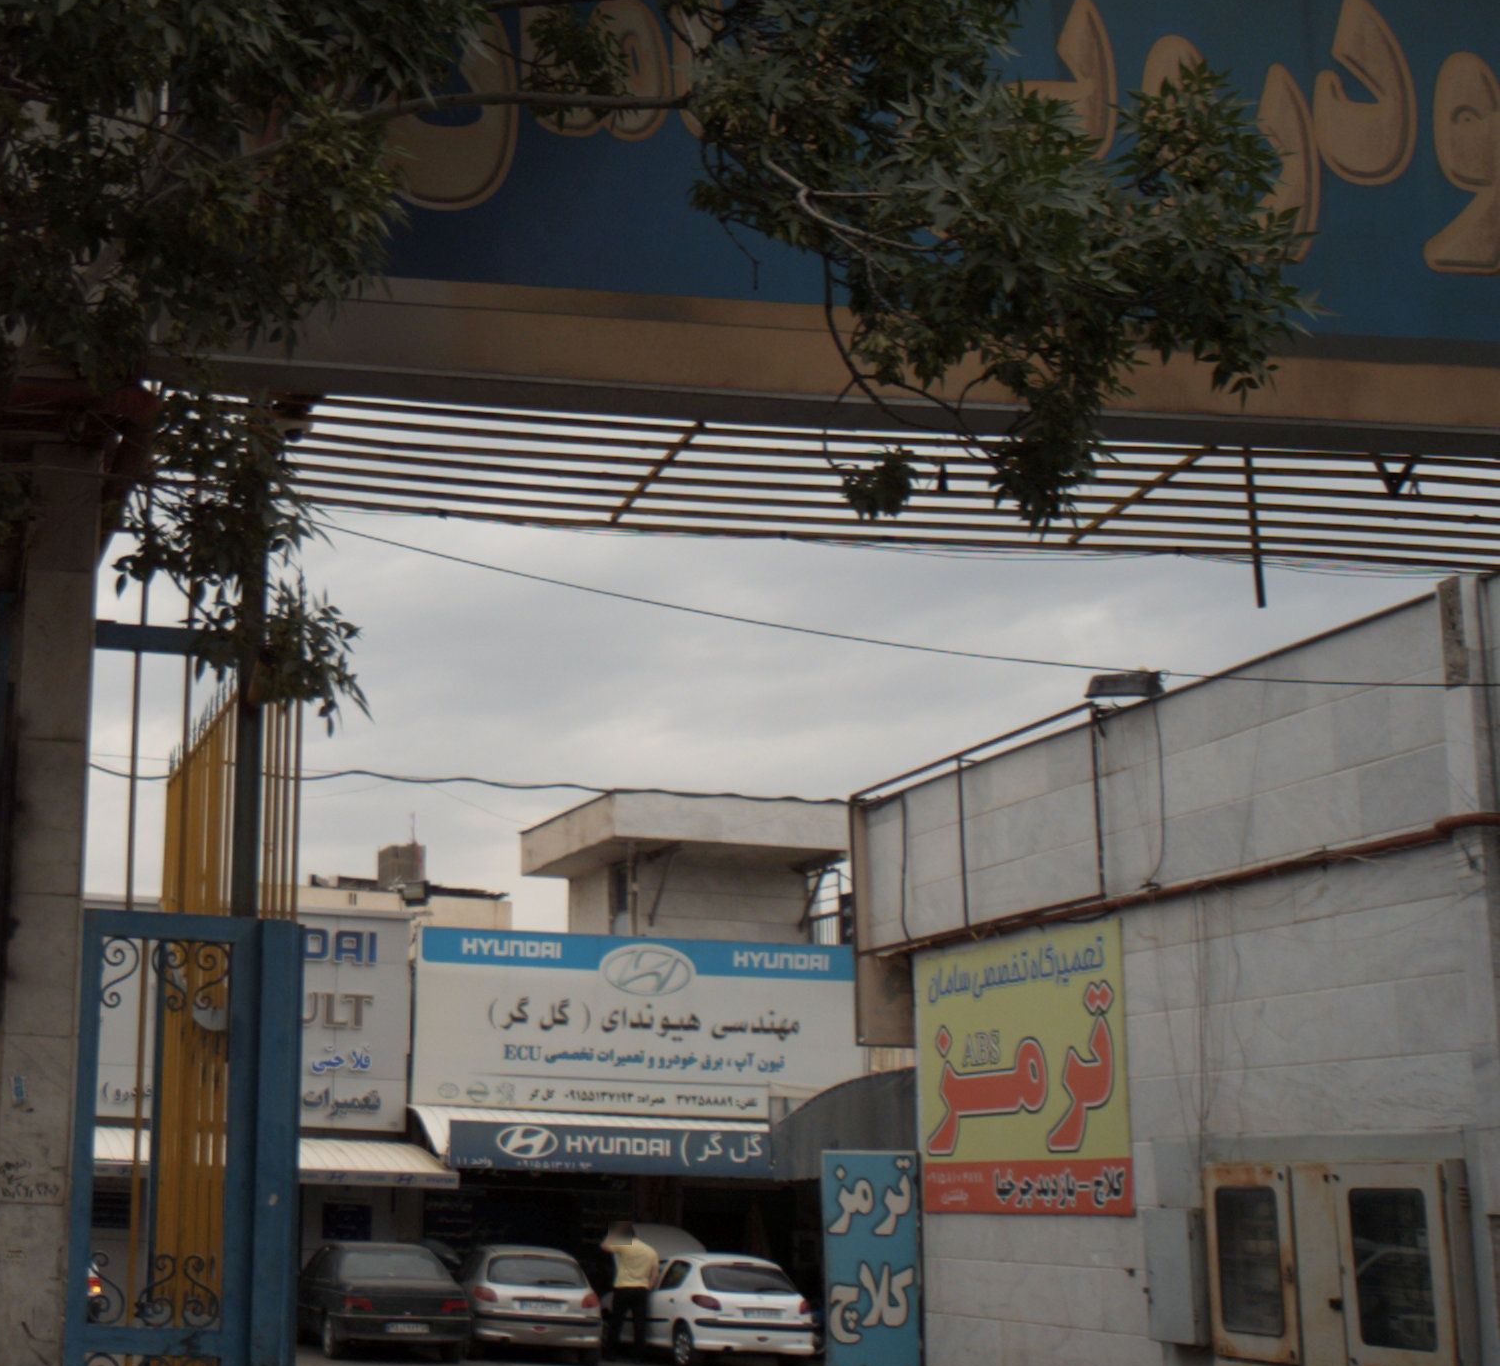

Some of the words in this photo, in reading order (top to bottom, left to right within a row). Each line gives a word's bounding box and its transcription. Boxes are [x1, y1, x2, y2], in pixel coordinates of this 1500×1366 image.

[461, 937, 563, 959] HYUNDAI
[733, 950, 830, 972] HYUNDAI
[1030, 936, 1105, 984] تعمیرگاه
[973, 951, 1029, 999] تخصصی
[601, 1003, 701, 1041] هیوندای
[711, 1010, 800, 1041] مهندسی
[504, 1043, 542, 1061] ECU
[545, 1047, 594, 1064] تخصصی
[597, 1049, 645, 1068] تعمیرات
[657, 1052, 698, 1070] خودرو
[961, 1030, 1001, 1068] ABS
[701, 1055, 724, 1071] برق
[926, 979, 1115, 1156] ترمز
[565, 1134, 671, 1158] HYUNDAI
[828, 1156, 913, 1236] ترمز
[828, 1260, 915, 1344] کلاچ
